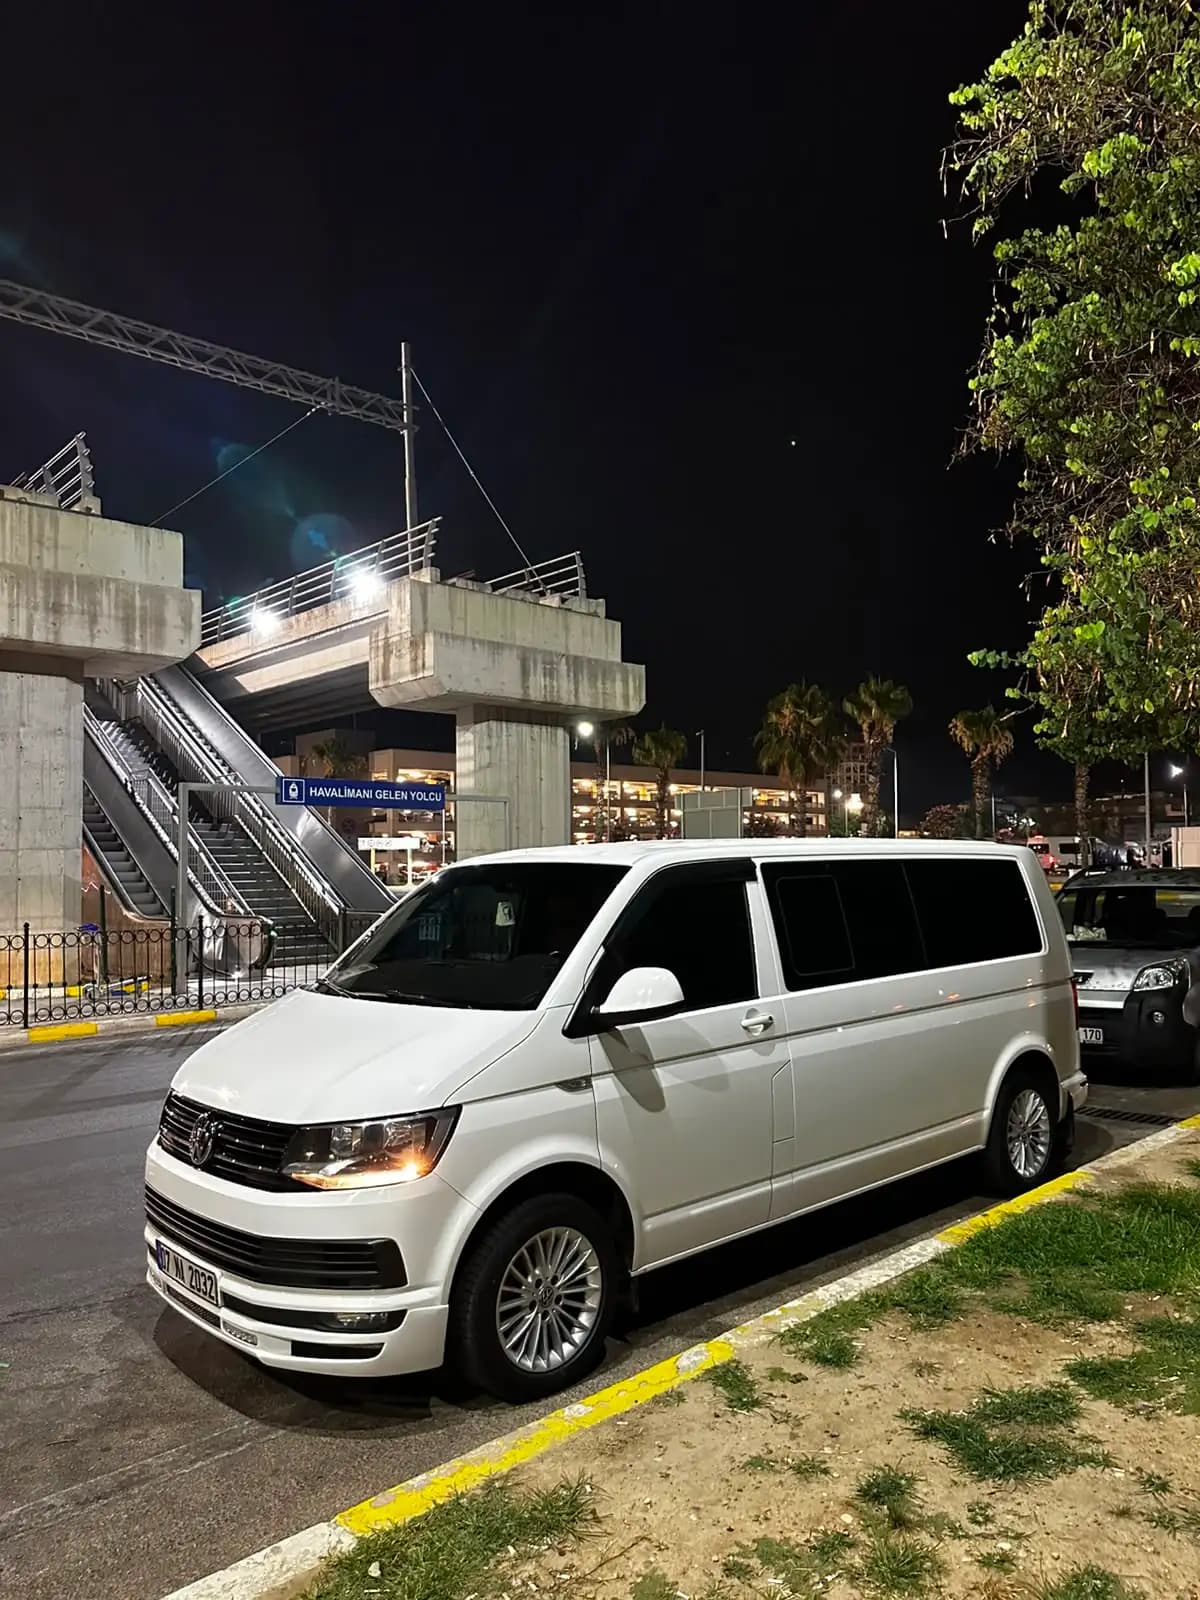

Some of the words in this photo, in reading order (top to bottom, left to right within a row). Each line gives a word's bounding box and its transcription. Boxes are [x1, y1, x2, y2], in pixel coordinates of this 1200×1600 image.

[309, 786, 373, 799] HAVALİMANI
[375, 789, 408, 801] GELEN
[409, 791, 442, 802] YOLCU
[1084, 1028, 1101, 1041] 170
[188, 1265, 215, 1301] 2032
